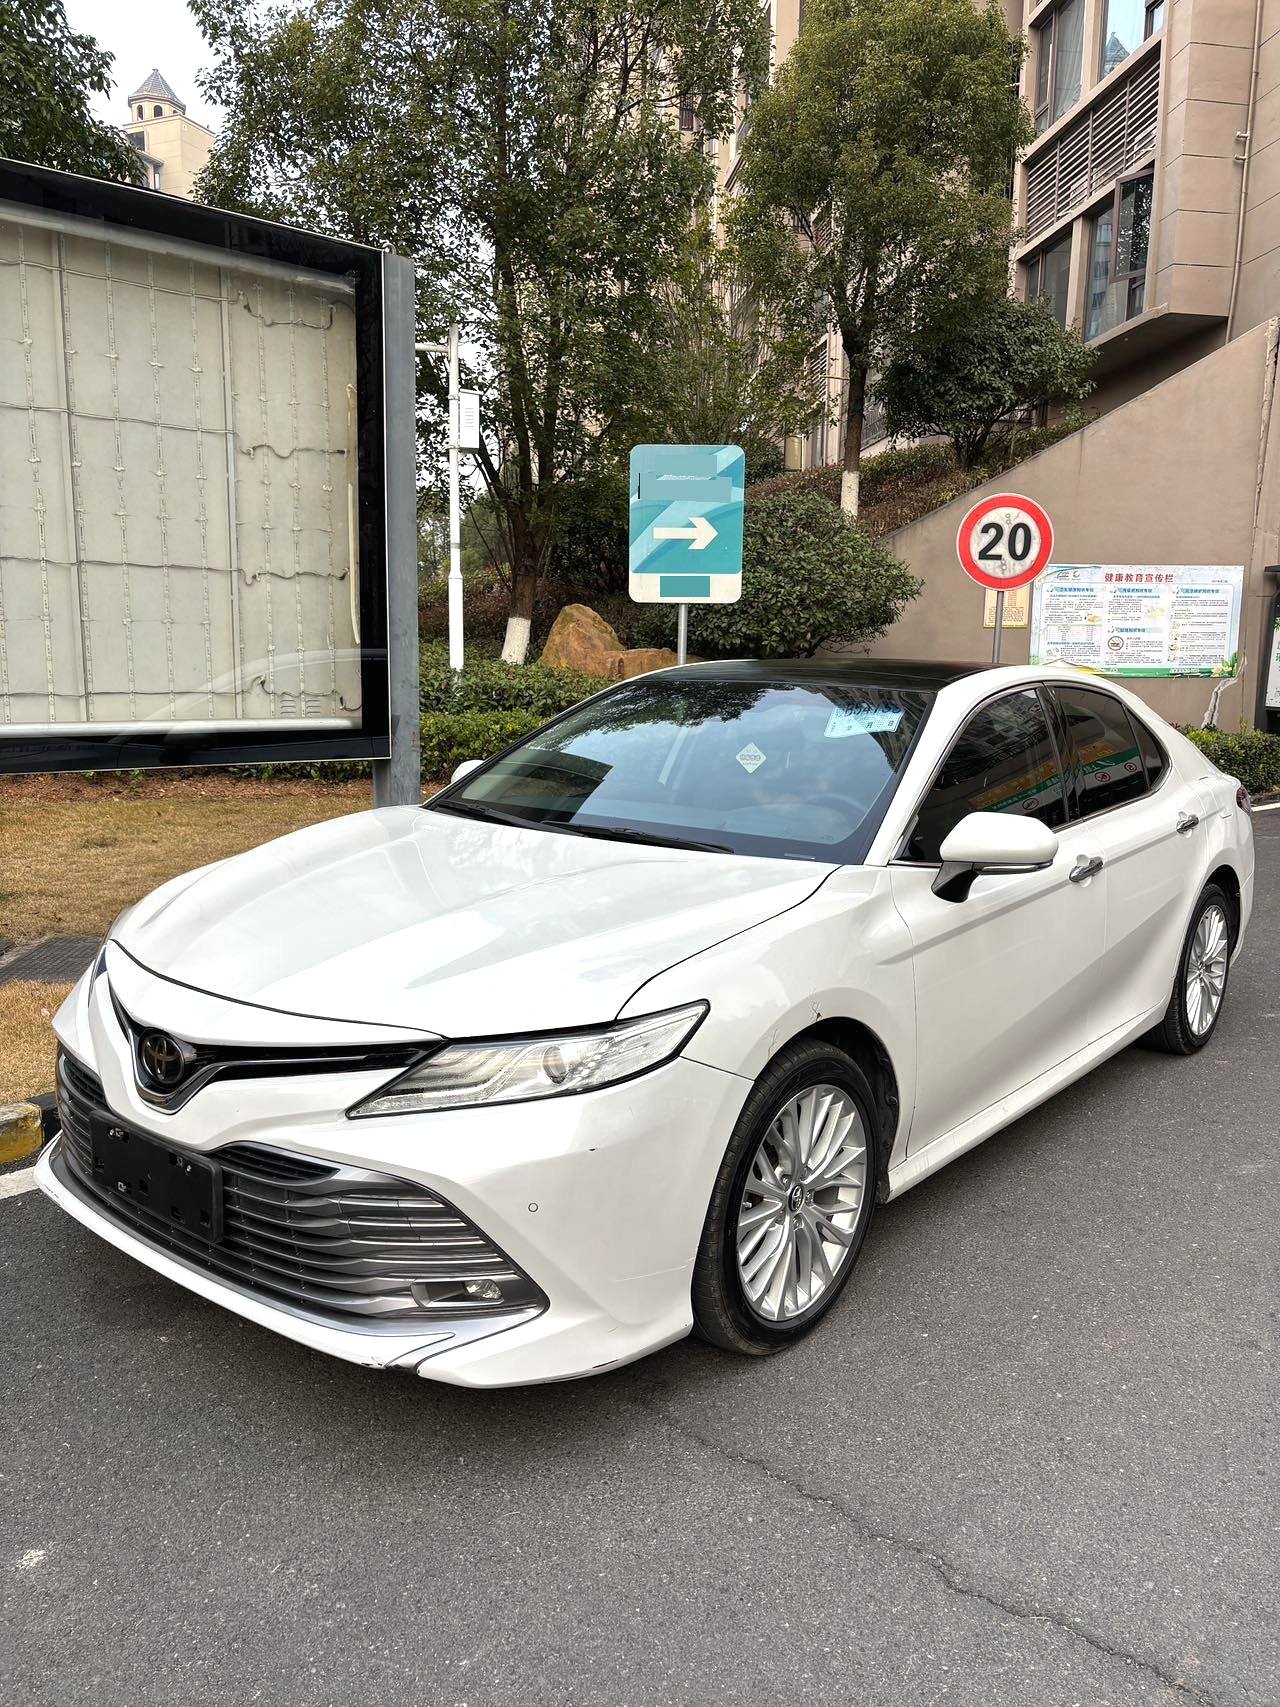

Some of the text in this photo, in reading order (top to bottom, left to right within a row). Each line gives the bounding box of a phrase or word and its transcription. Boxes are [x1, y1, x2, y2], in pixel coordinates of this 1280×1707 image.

[978, 522, 1032, 561] 20
[1104, 572, 1174, 583] 健康教育宣传栏
